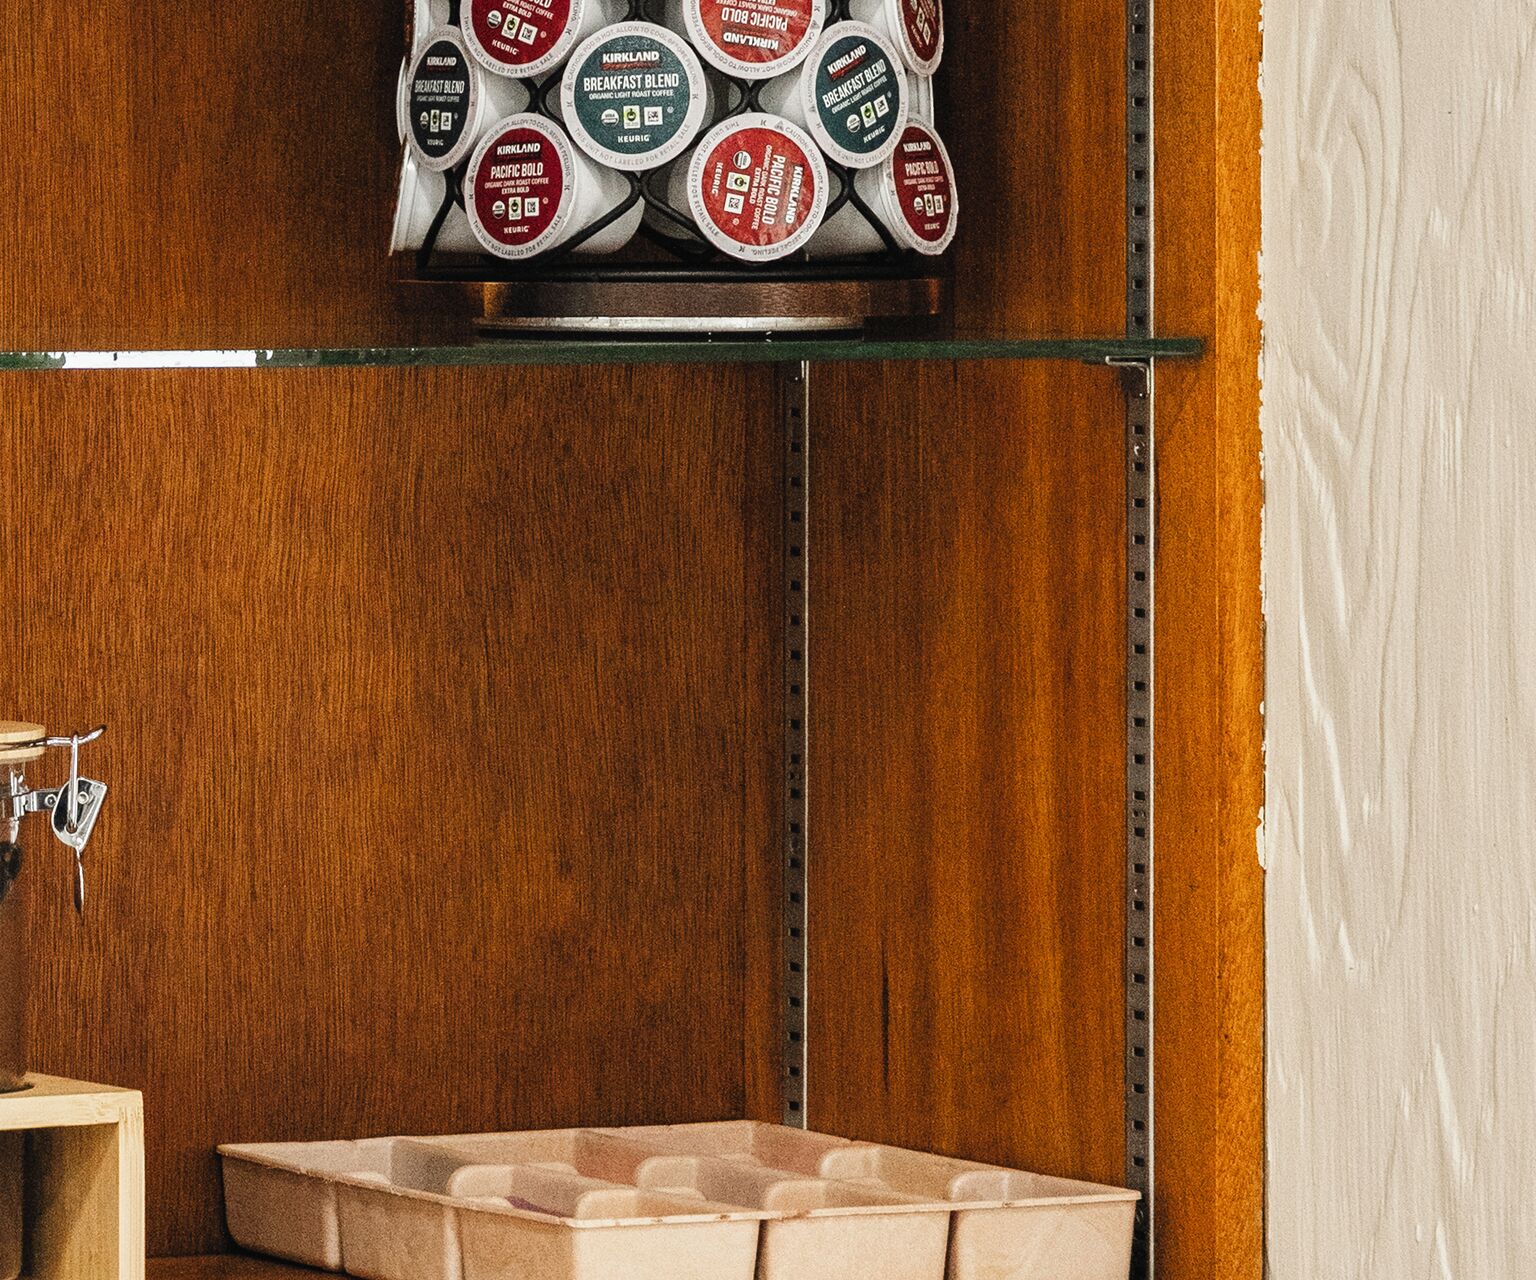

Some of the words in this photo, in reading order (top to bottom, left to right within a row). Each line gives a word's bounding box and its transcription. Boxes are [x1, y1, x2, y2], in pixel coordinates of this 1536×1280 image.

[502, 1, 519, 13] EXTRA
[517, 7, 532, 19] BOLD
[519, 0, 536, 12] ROAST
[535, 7, 554, 20] COFFEE
[737, 0, 758, 11] ROAST
[757, 3, 773, 13] DARK
[773, 6, 798, 18] ORGANIC
[721, 7, 749, 25] BOLD
[749, 11, 789, 32] PACIFIC
[491, 39, 519, 56] KEURIG
[723, 32, 779, 51] KIRKLAND
[426, 56, 457, 66] KIRKLAND
[602, 50, 660, 64] KIRKLAND
[827, 44, 867, 75] KIRKLAND
[414, 79, 444, 94] BREAKFAST
[443, 80, 465, 94] BLEND
[583, 74, 643, 92] BREAKFAST
[644, 73, 680, 89] BLEND
[821, 72, 866, 109] BREAKFAST
[863, 58, 887, 83] BLEND
[588, 91, 614, 100] ORGANIC
[614, 90, 631, 99] LIGHT
[631, 89, 651, 98] ROAST
[651, 88, 674, 97] COFFEE
[617, 134, 651, 143] KEURIG
[863, 125, 886, 144] KEURIG
[496, 142, 541, 156] KIRKLAND
[762, 144, 773, 171] ORGANIC
[490, 163, 521, 180] PACIFIC
[521, 161, 544, 177] BOLD
[711, 162, 724, 197] KEURIG
[752, 167, 762, 187] EXTRA
[759, 170, 769, 187] DARK
[767, 154, 786, 196] PACIFIC
[484, 180, 504, 189] ORGANIC
[503, 179, 516, 187] DARK
[515, 178, 531, 186] ROAST
[531, 177, 549, 185] COFFEE
[501, 187, 517, 195] EXTRA
[516, 185, 530, 194] BOLD
[749, 187, 758, 205] BOLD
[756, 187, 766, 208] ROAST
[785, 165, 803, 224] KIRKLAND
[751, 207, 762, 230] COFFEE
[761, 196, 779, 225] BOLD
[503, 225, 530, 234] KEURIG
